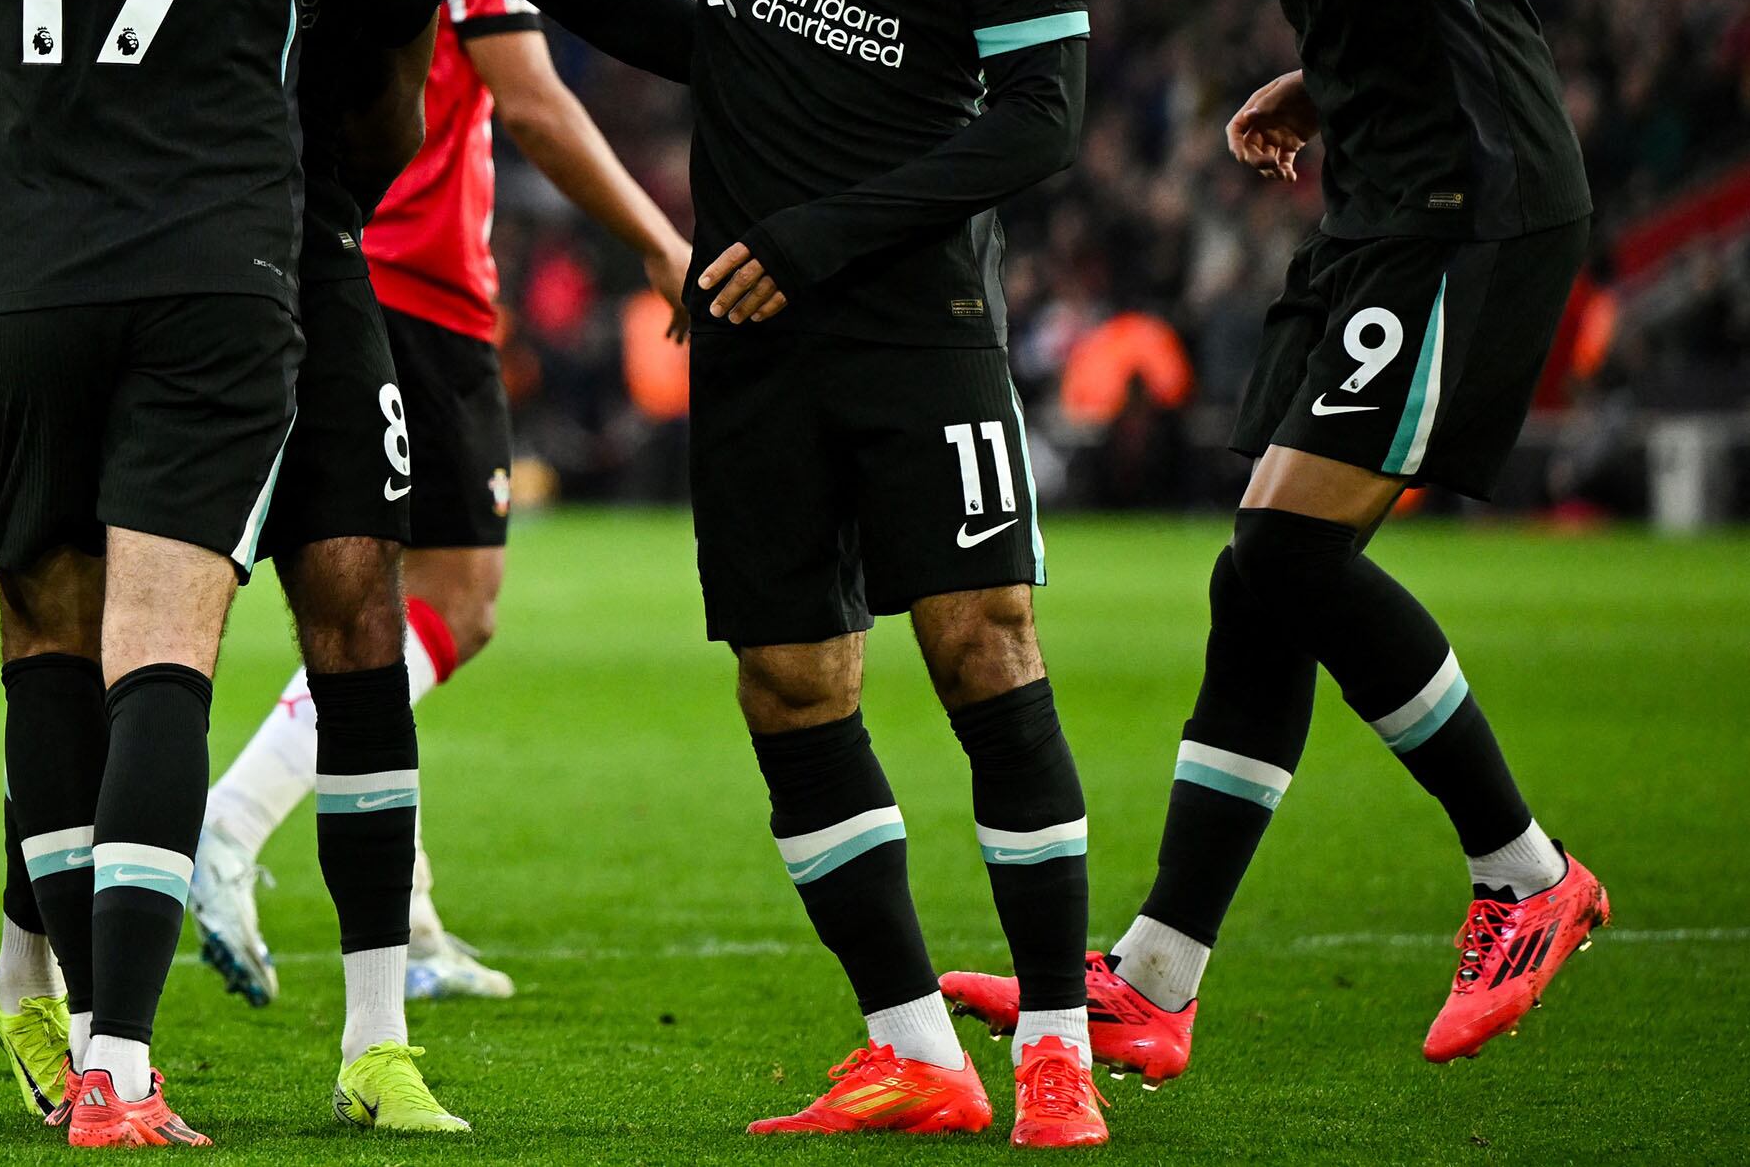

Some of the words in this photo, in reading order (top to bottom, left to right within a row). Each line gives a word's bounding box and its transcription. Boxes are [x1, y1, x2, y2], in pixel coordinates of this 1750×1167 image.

[1339, 306, 1404, 394] 9
[378, 383, 411, 477] 8
[944, 420, 1017, 516] 11
